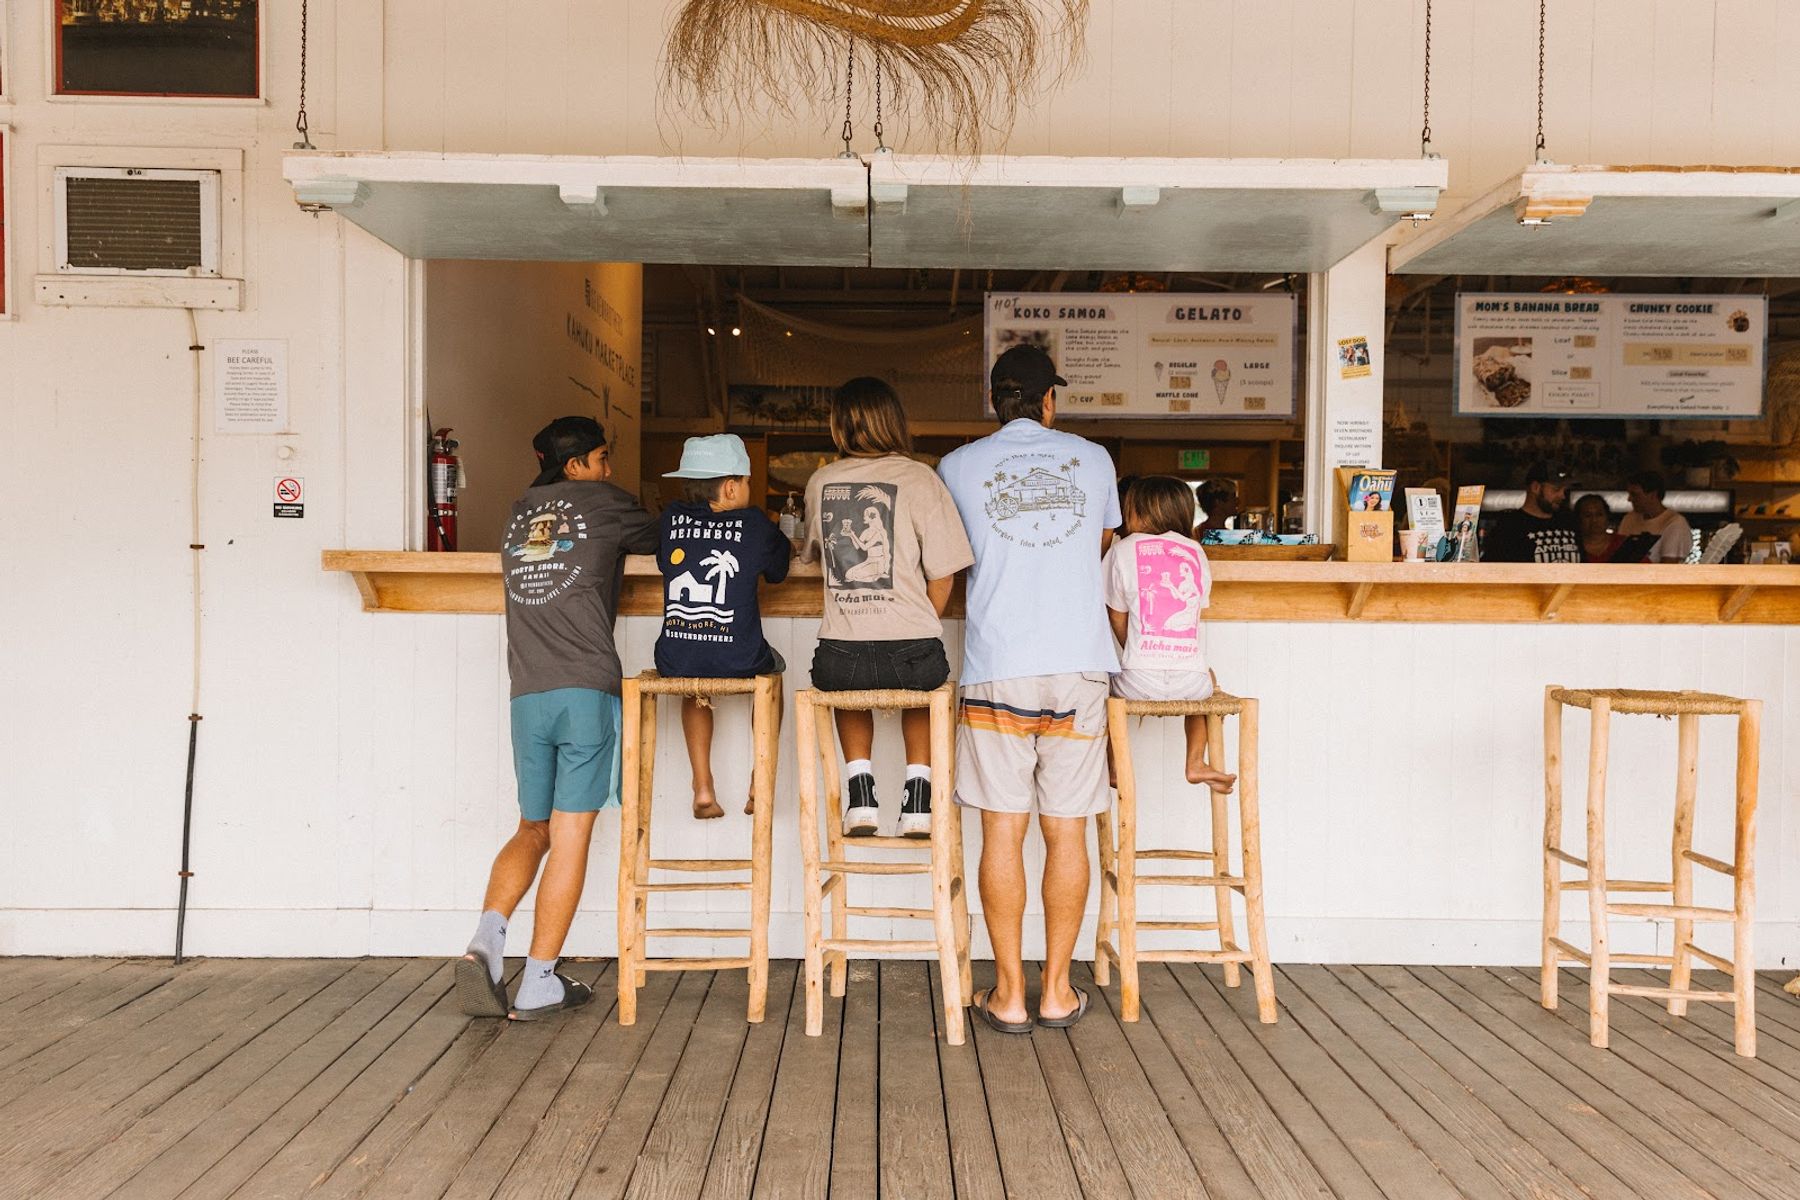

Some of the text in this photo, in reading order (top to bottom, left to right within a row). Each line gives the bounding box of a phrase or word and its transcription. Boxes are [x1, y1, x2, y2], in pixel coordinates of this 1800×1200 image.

[995, 298, 1020, 310] HOT
[1475, 301, 1600, 312] MOM'S BANANA BREAD
[1630, 303, 1713, 314] CHUNKY COOKIE
[1014, 307, 1106, 319] KOKO SAMOA
[1175, 307, 1242, 321] GELATO
[227, 356, 273, 364] BEE CAREFUL
[596, 336, 635, 388] MARKETPLACE
[1359, 475, 1394, 491] Oahu
[557, 500, 573, 509] OF
[574, 514, 588, 539] THE
[671, 514, 743, 529] LOVE YOUR
[669, 528, 743, 543] NEIGHBOR
[991, 522, 1014, 542] burgers
[1020, 539, 1036, 548] fries
[511, 564, 535, 576] NORTH
[523, 572, 549, 580] HAWAII
[561, 565, 583, 589] HALEIWA
[862, 594, 886, 602] mai
[666, 619, 685, 627] NORTH
[665, 629, 734, 643] @SEVENBROTHERS
[1140, 640, 1172, 651] Aloha
